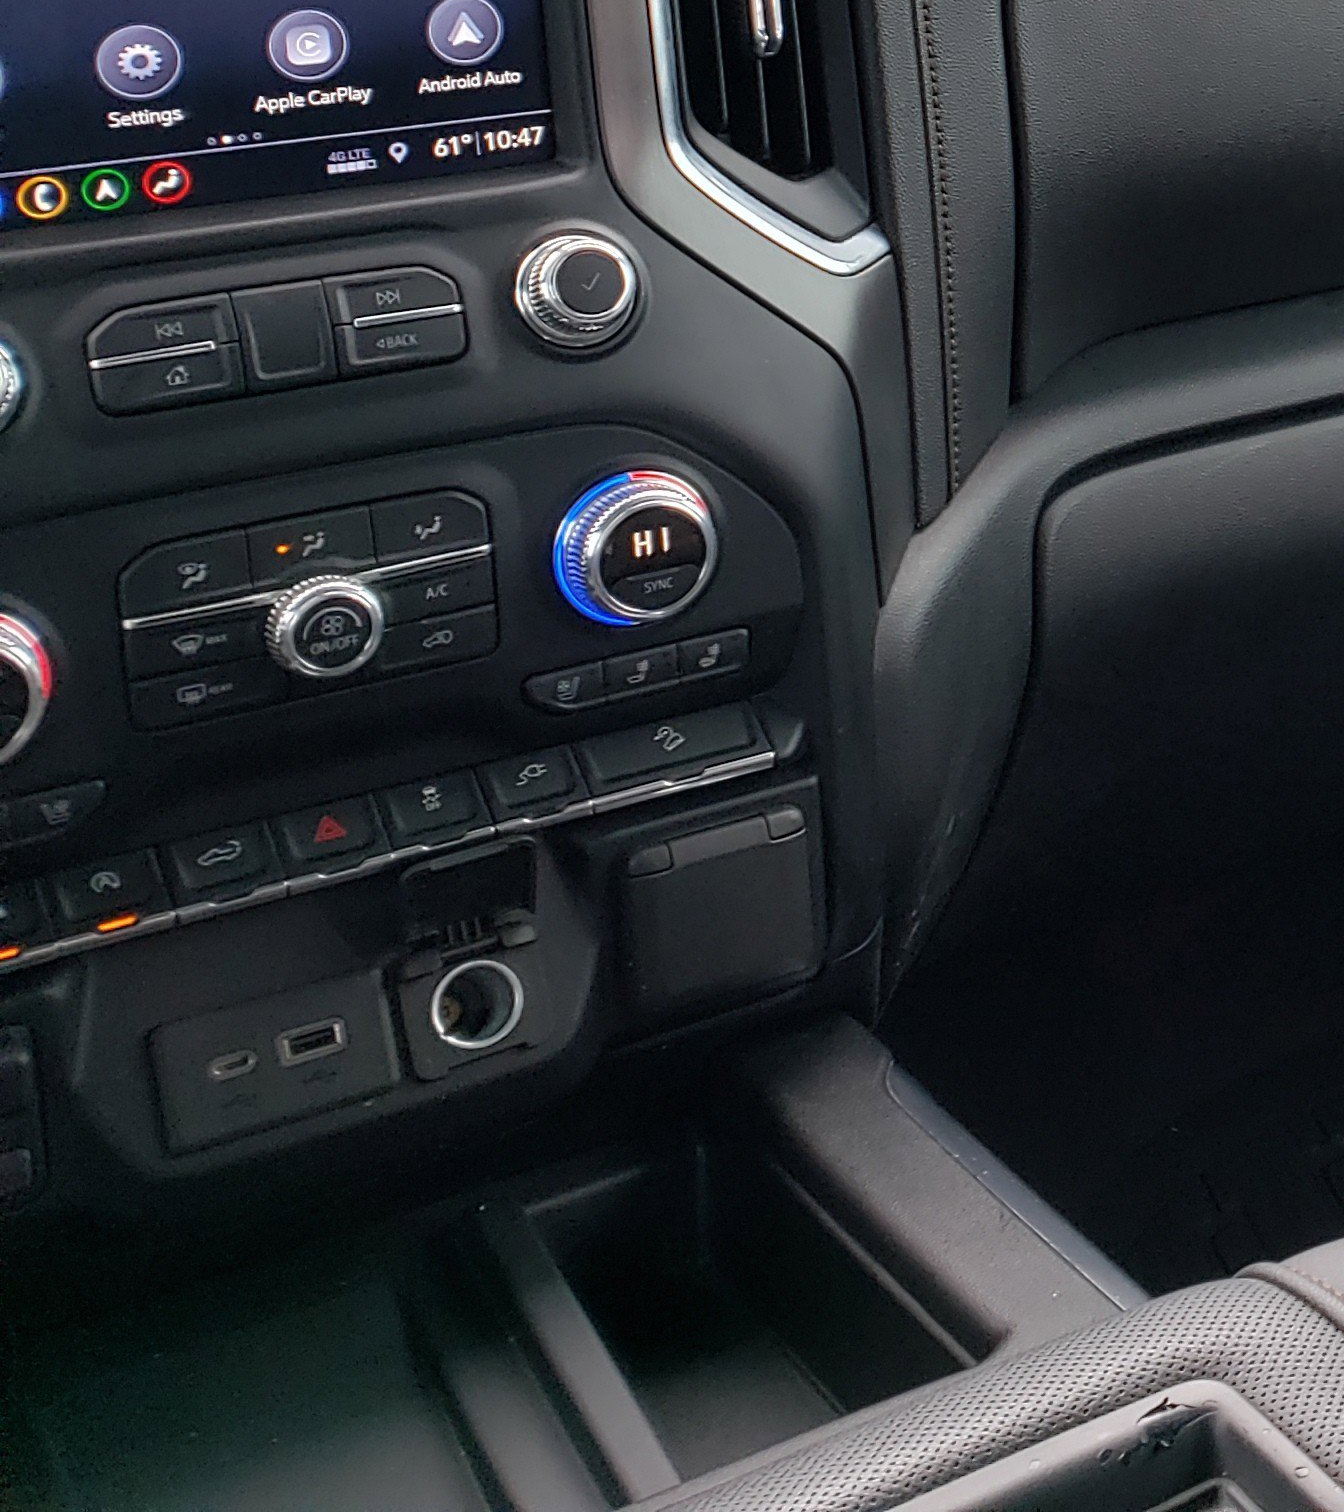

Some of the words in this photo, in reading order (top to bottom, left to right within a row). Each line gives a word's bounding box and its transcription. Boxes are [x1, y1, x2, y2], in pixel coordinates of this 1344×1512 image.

[417, 73, 482, 94] Android
[484, 70, 522, 87] Auto
[254, 92, 306, 115] Apple
[308, 86, 373, 106] CarPlay
[106, 108, 185, 129] Settings
[483, 125, 546, 152] 10:47
[327, 151, 346, 162] 4G
[348, 148, 371, 160] LTE
[386, 333, 418, 348] BACK
[425, 583, 448, 601] A/C
[643, 576, 675, 595] SYNC
[309, 634, 359, 656] ON/OFF
